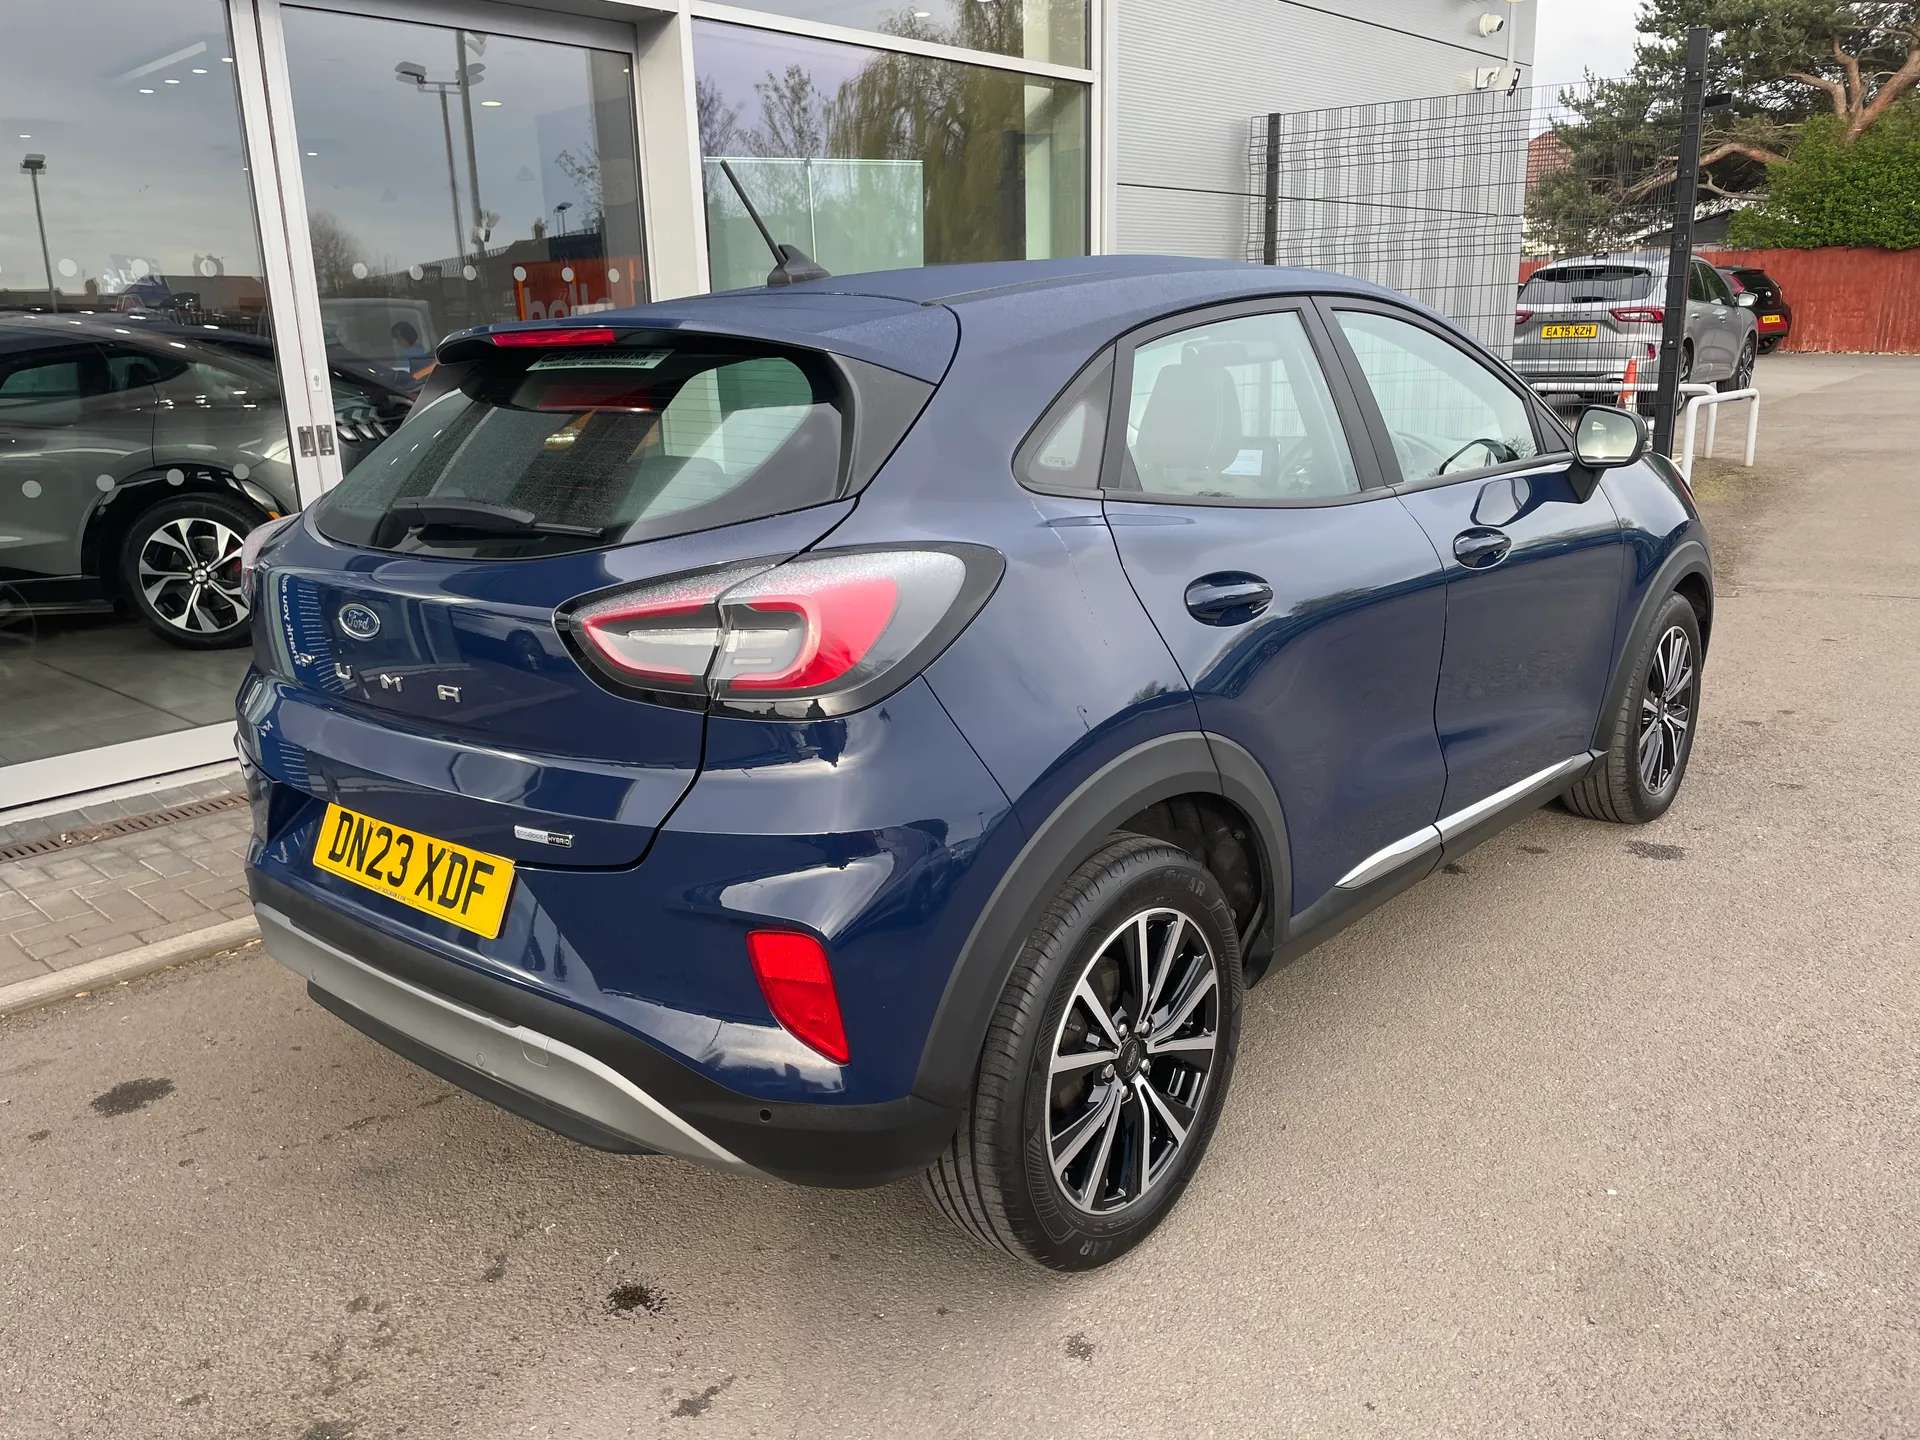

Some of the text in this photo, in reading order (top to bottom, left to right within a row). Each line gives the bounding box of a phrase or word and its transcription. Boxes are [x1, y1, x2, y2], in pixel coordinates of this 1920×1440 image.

[524, 282, 613, 320] hell
[1546, 325, 1592, 337] EA75 XZH
[328, 811, 495, 916] DN23 XDF
